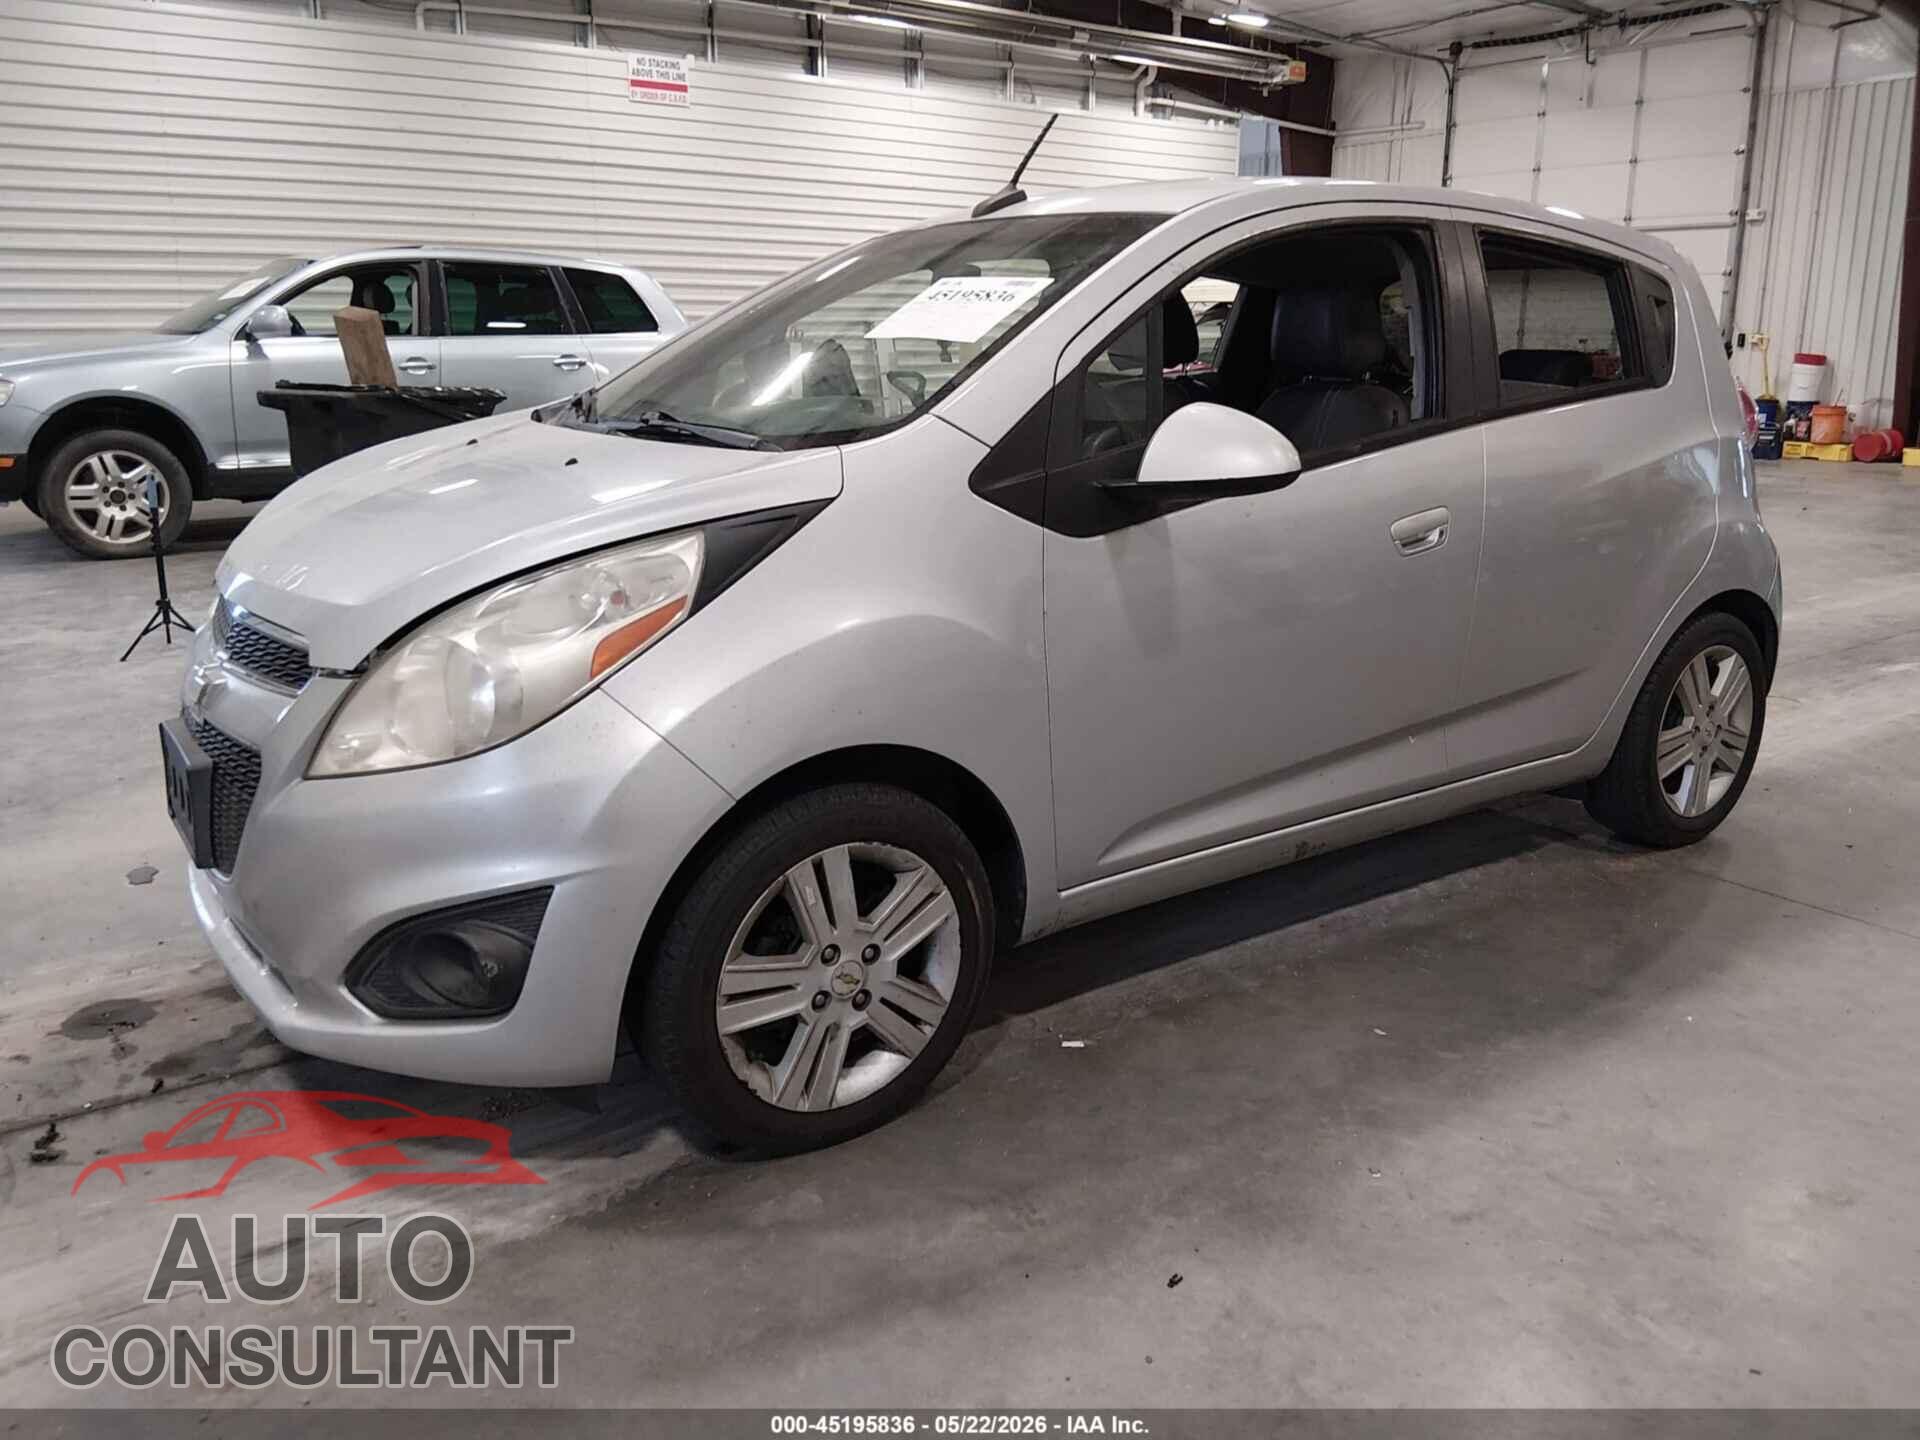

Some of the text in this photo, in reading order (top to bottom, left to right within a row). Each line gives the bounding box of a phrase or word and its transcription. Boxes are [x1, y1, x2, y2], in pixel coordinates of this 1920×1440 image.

[636, 57, 681, 70] NO STACKING
[632, 67, 686, 82] ABOVE THIS LINE
[928, 289, 1016, 303] 45195836
